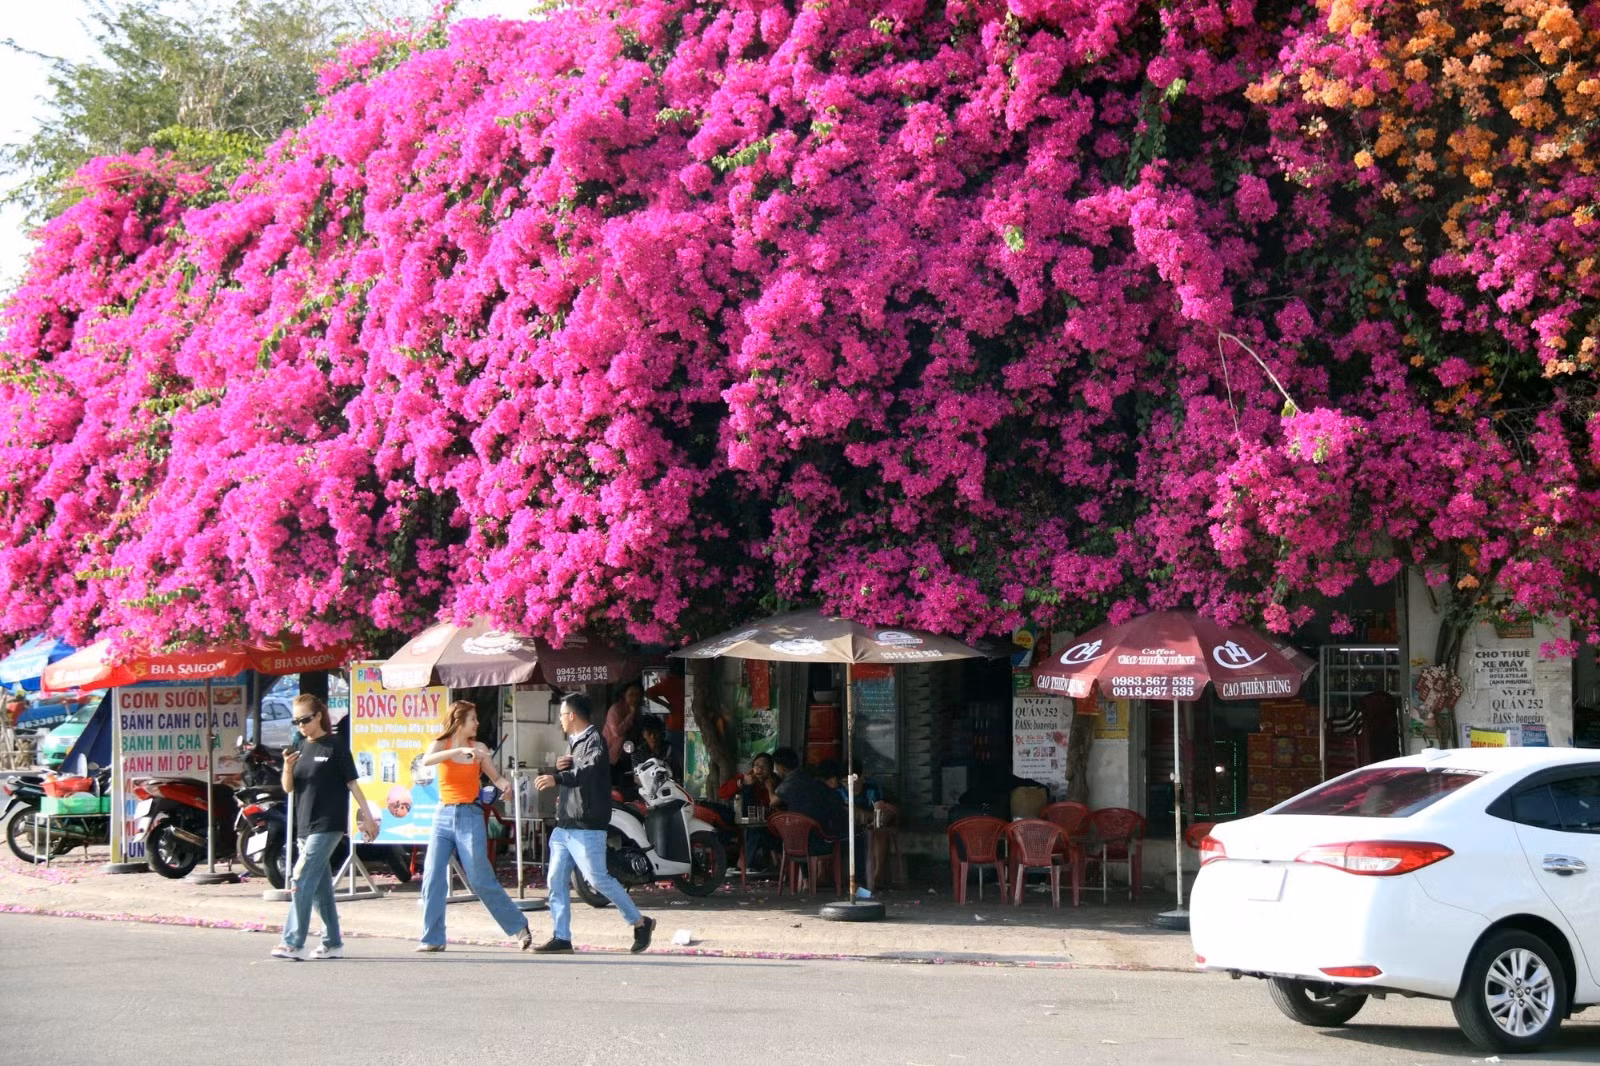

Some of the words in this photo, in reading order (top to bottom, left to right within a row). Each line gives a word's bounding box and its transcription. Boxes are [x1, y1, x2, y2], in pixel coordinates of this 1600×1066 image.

[1475, 651, 1498, 659] CHO
[1500, 648, 1530, 658] THUÊ
[274, 658, 293, 669] BIA
[1482, 660, 1497, 668] XE
[1498, 659, 1525, 668] MÁY
[150, 664, 175, 675] BIA
[556, 666, 591, 675] 0942.574
[593, 665, 608, 673] 986
[556, 674, 576, 682] 0972
[577, 673, 591, 681] 900
[1037, 675, 1050, 688] CAO
[1112, 676, 1168, 686] 0983.867
[1172, 676, 1195, 686] 535
[1112, 686, 1168, 696] 0918.867
[1171, 686, 1194, 696] 535
[1222, 682, 1239, 697] CAO
[1502, 688, 1536, 696] WIFI
[121, 690, 158, 709] CƠM
[356, 688, 398, 718] BÔNG
[1527, 698, 1544, 709] 252
[1043, 707, 1058, 718] 252
[1493, 712, 1514, 724] PASS:
[158, 713, 190, 729] CANH
